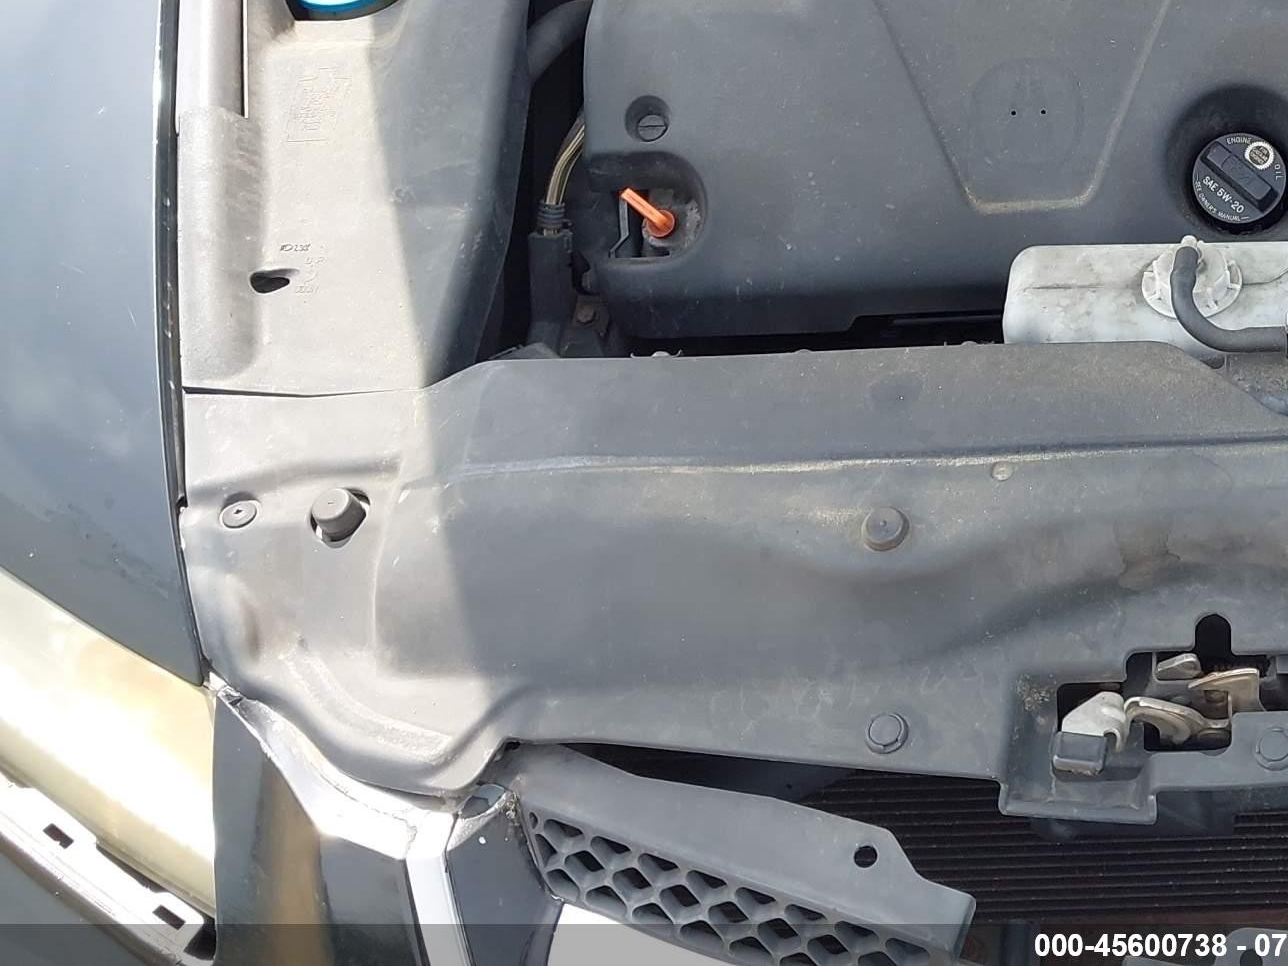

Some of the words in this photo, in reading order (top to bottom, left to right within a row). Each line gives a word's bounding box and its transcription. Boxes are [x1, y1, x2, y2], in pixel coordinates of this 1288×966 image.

[1226, 136, 1252, 145] ENGINE
[1274, 163, 1283, 181] OIL
[1202, 176, 1219, 192] SAE
[1216, 188, 1245, 213] 5W-20
